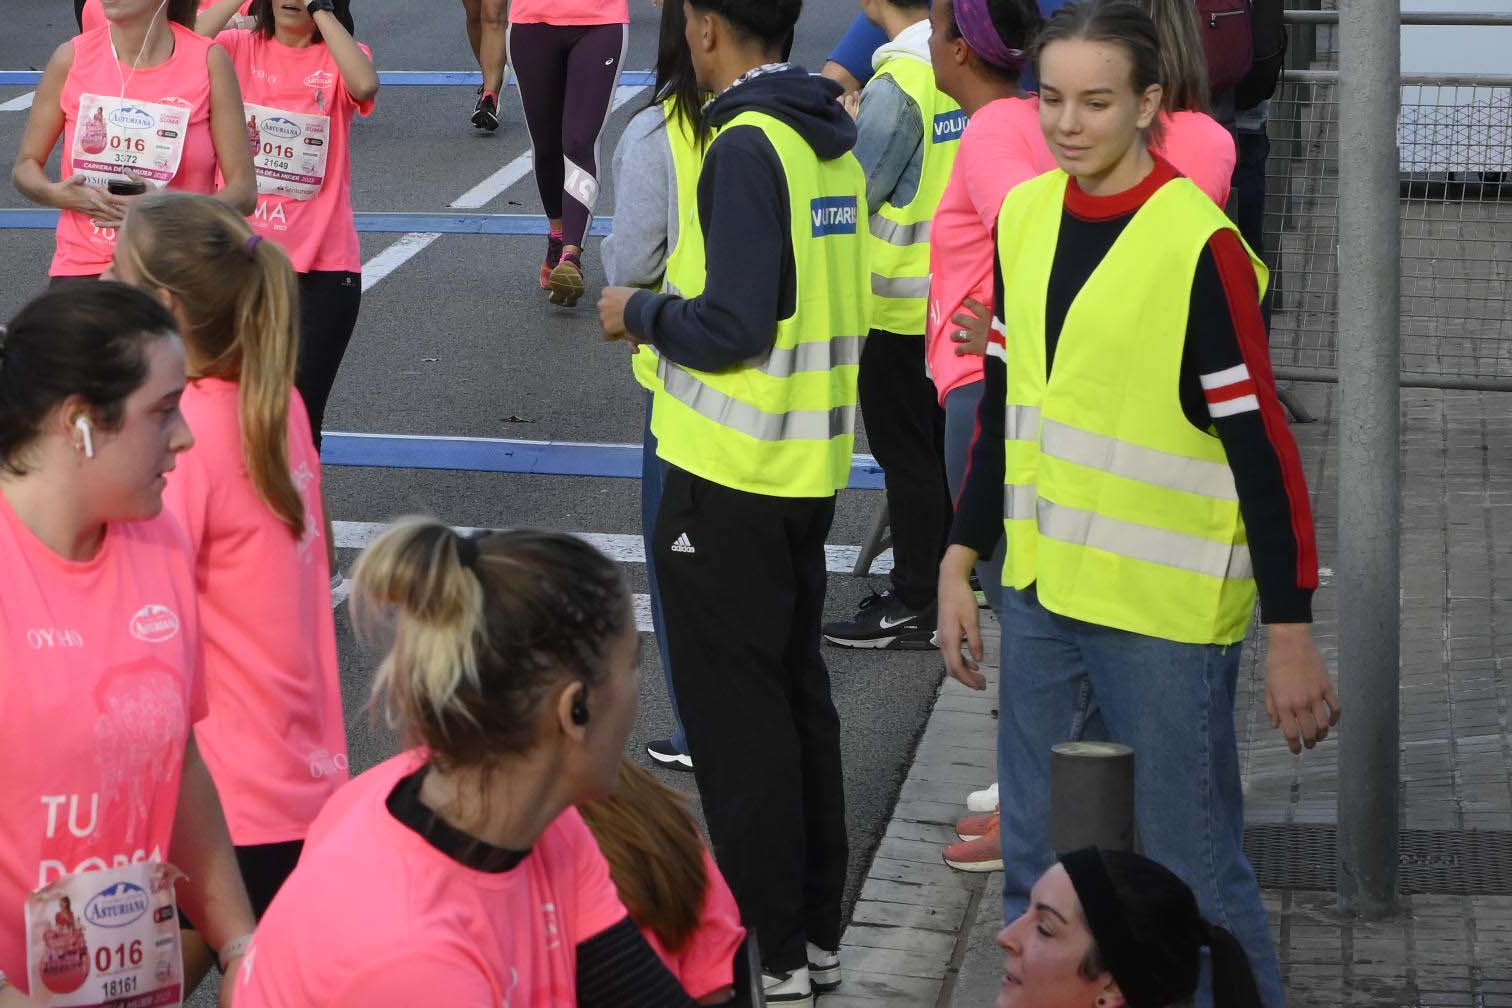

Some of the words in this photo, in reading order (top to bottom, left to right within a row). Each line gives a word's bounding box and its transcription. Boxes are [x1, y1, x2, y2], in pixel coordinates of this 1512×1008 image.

[110, 135, 145, 152] 016
[263, 142, 294, 159] 016
[264, 158, 289, 170] 21649
[671, 545, 695, 553] adidas
[40, 792, 99, 839] TU
[91, 897, 145, 919] ASTURIANA
[94, 938, 143, 972] 016
[102, 975, 138, 996] 18161
